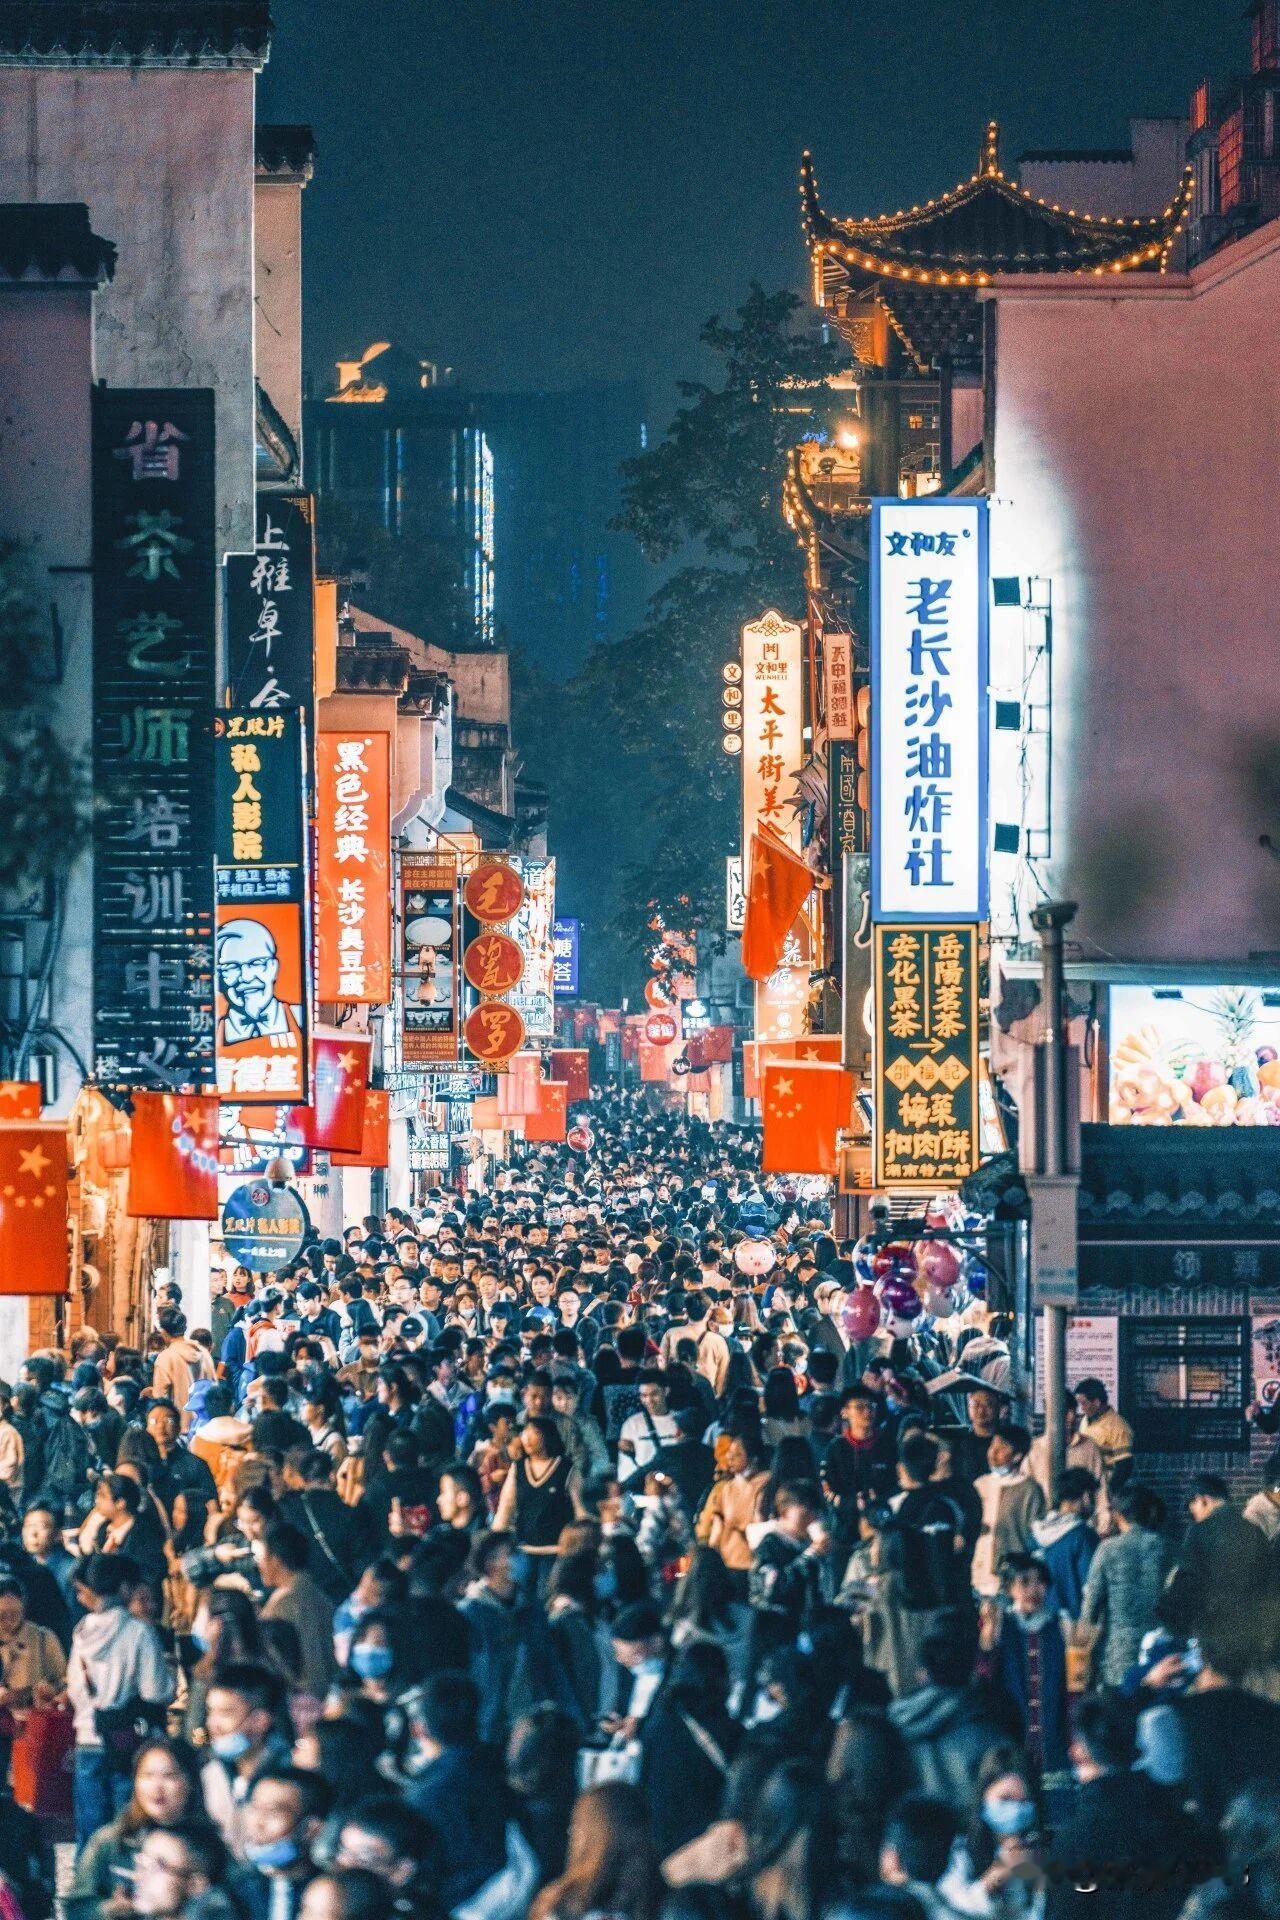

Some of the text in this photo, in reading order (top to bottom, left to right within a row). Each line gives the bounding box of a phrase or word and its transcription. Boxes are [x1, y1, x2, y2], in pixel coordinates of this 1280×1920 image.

[885, 531, 958, 557] 文和友
[726, 665, 739, 725] 文和里
[754, 662, 788, 674] 文和里
[112, 420, 196, 1086] 省茶艺师培训中心
[227, 716, 285, 738] 黑胶片
[757, 686, 787, 837] 太平街美
[904, 576, 955, 887] 老长沙油炸社
[231, 744, 263, 860] 私人影院
[333, 739, 370, 997] 黑色经典 长沙臭豆腐
[887, 933, 921, 1037] 安化黑茶
[933, 933, 966, 1037] 岳陽茗茶
[898, 1092, 957, 1128] 梅菜
